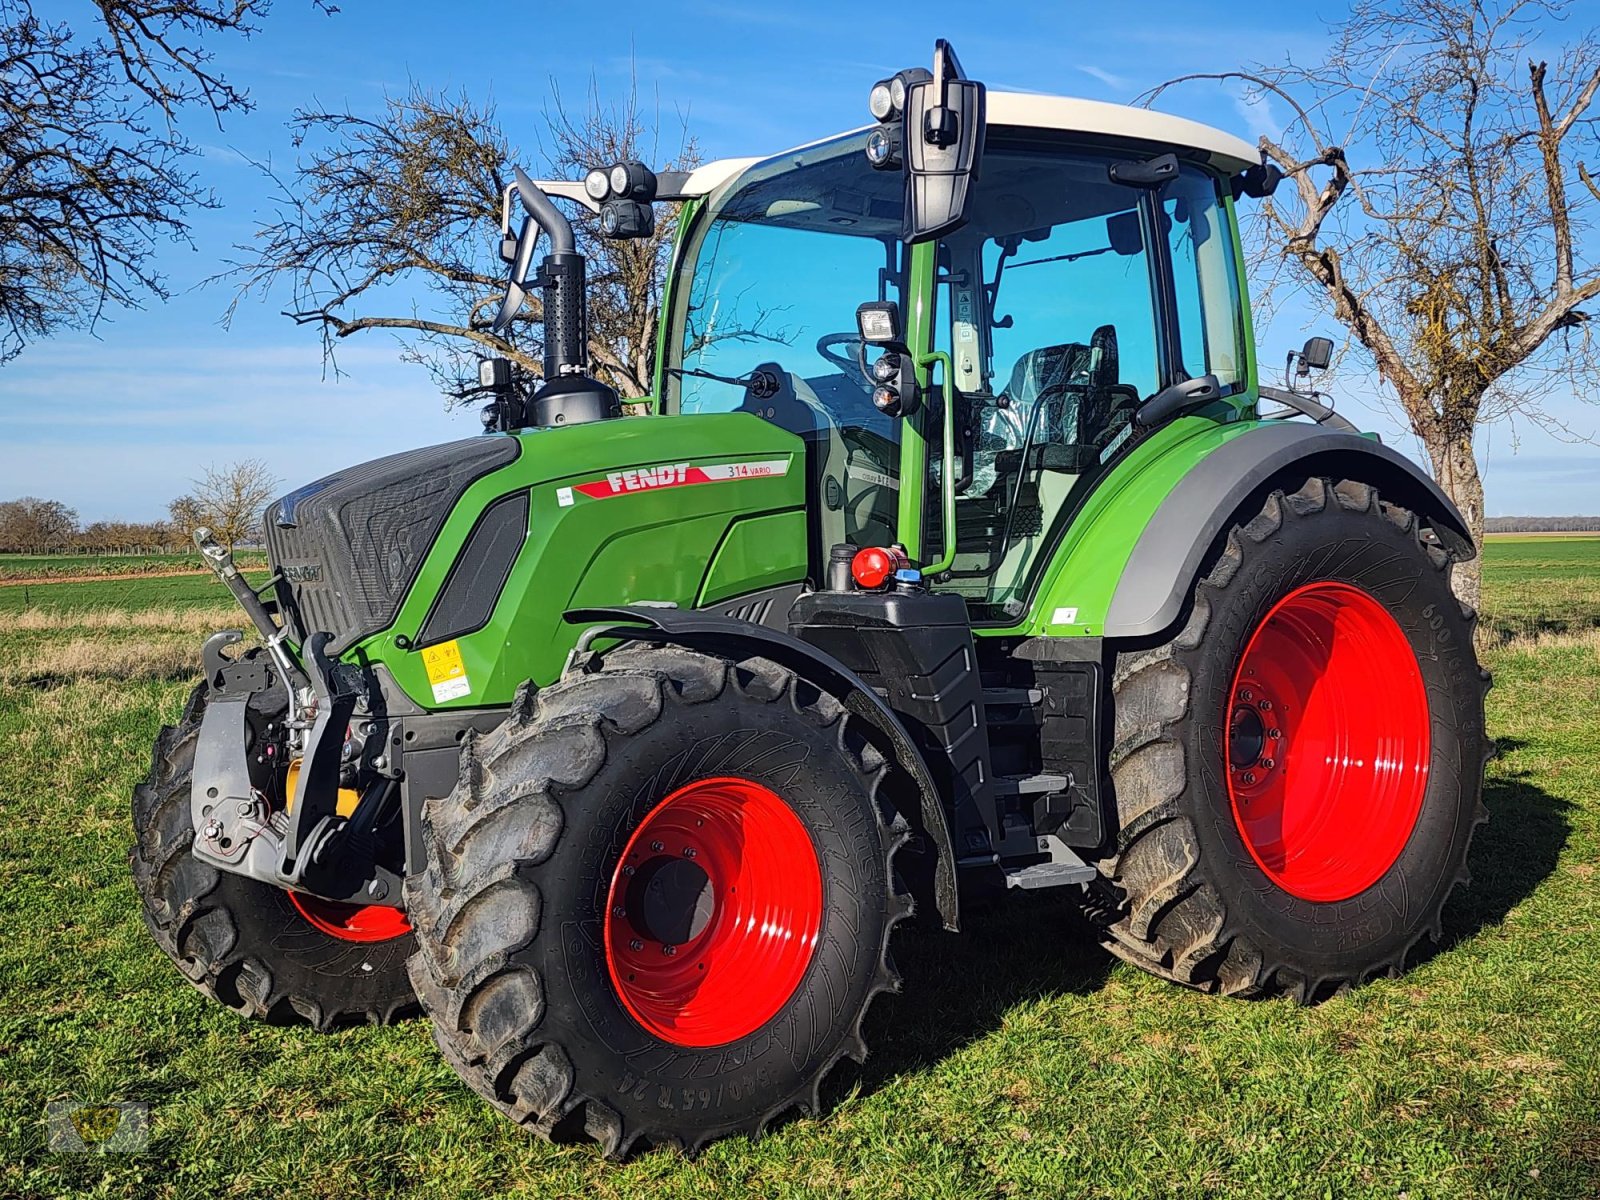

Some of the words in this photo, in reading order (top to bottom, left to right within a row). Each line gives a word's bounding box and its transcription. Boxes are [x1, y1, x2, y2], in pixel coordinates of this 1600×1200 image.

[606, 462, 690, 492] FENDT
[728, 466, 748, 477] 314
[750, 466, 771, 475] VARIO
